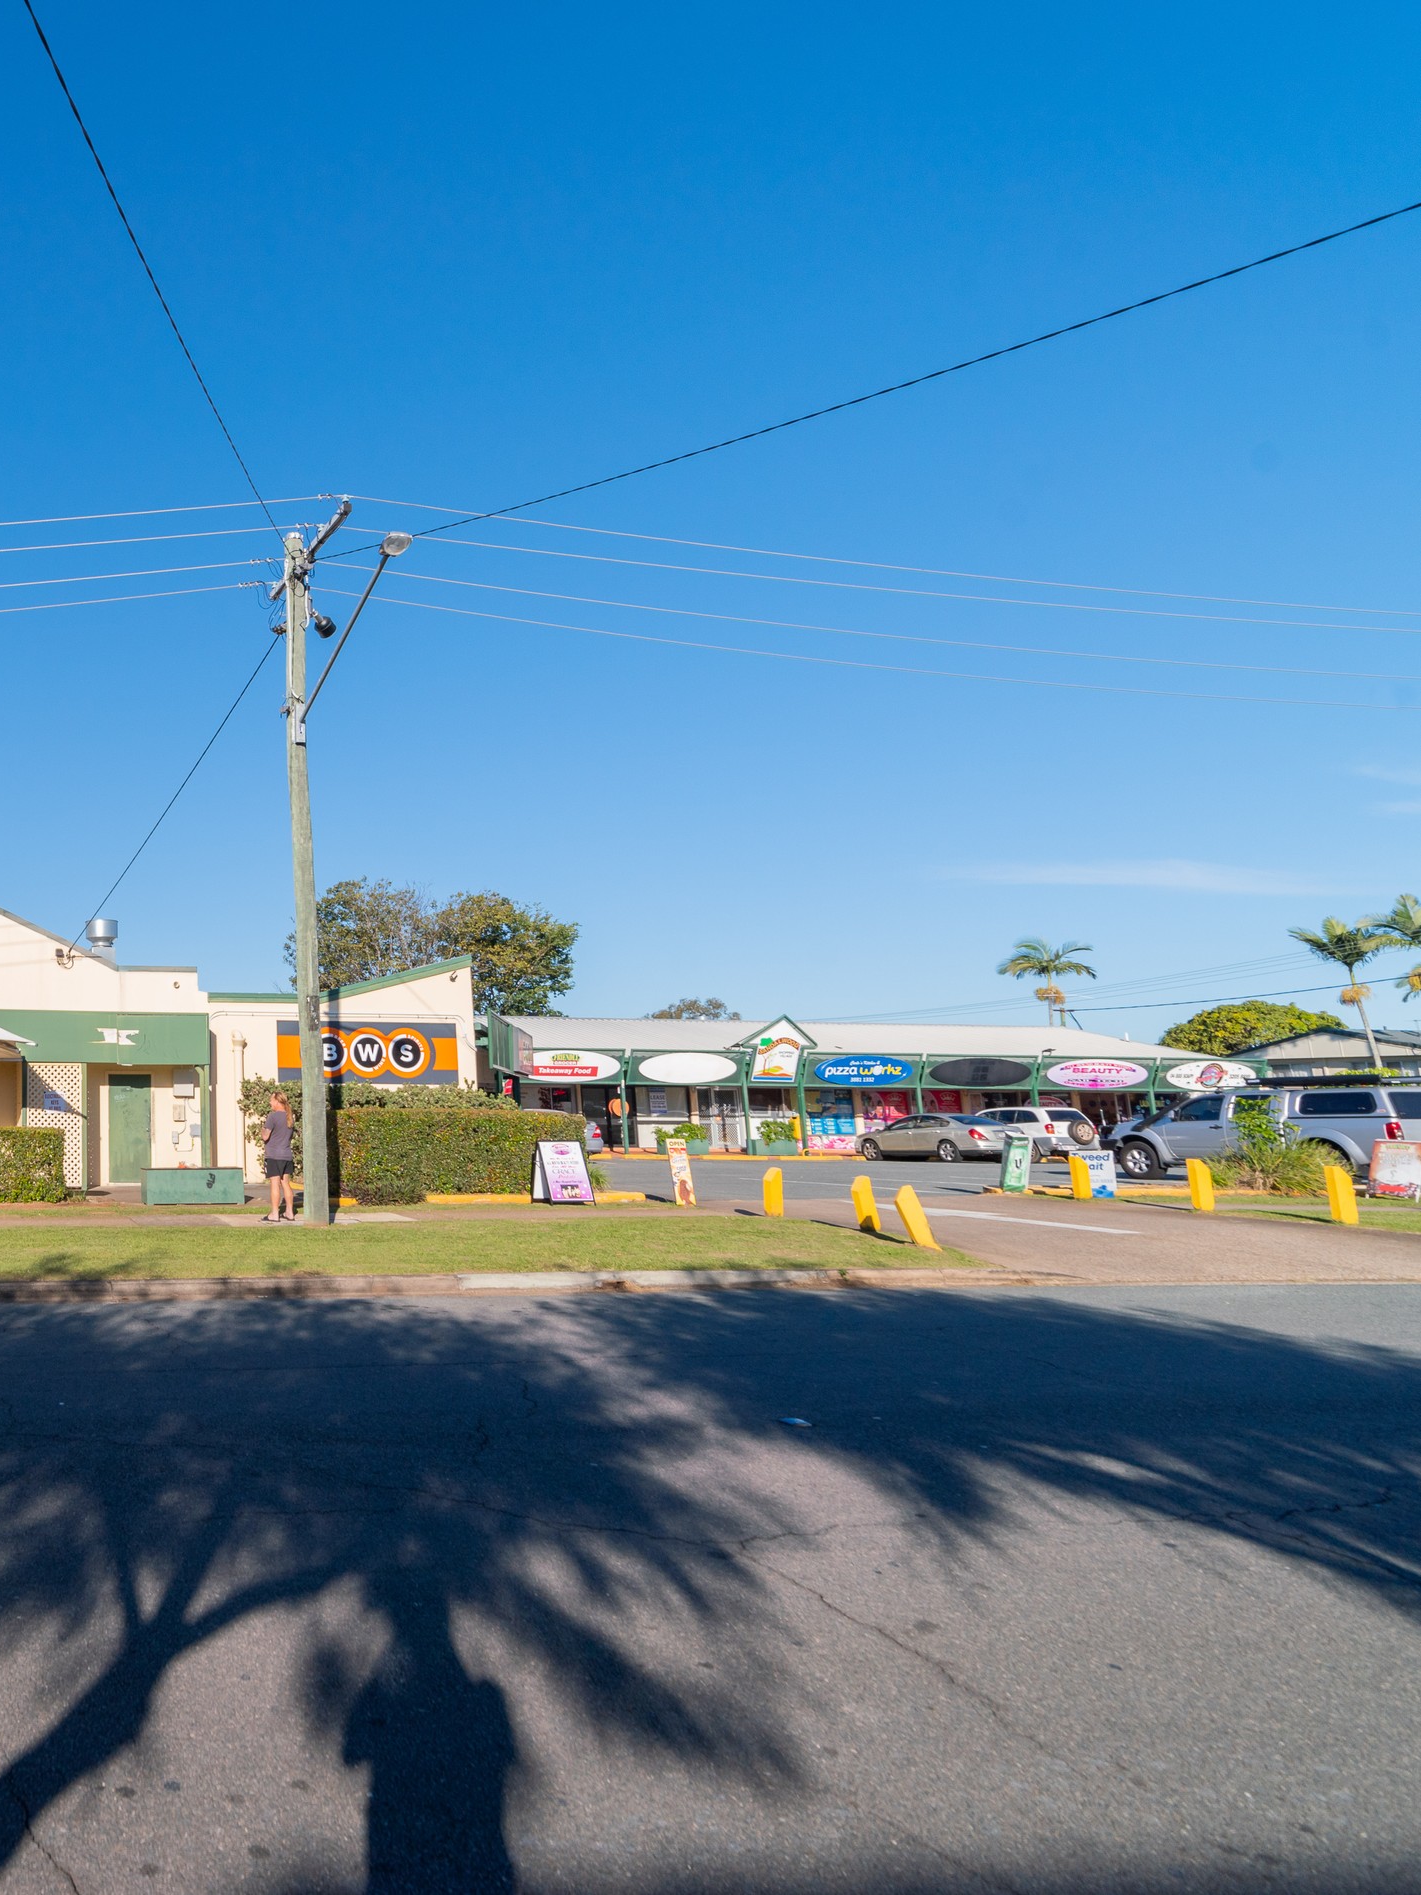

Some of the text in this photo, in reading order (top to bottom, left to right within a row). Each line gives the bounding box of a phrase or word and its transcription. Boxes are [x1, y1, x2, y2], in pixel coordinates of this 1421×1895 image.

[758, 1037, 799, 1055] SANDALWOOD
[538, 1066, 592, 1076] Takeaway Food
[824, 1066, 858, 1078] pizza
[1089, 1162, 1104, 1171] ait
